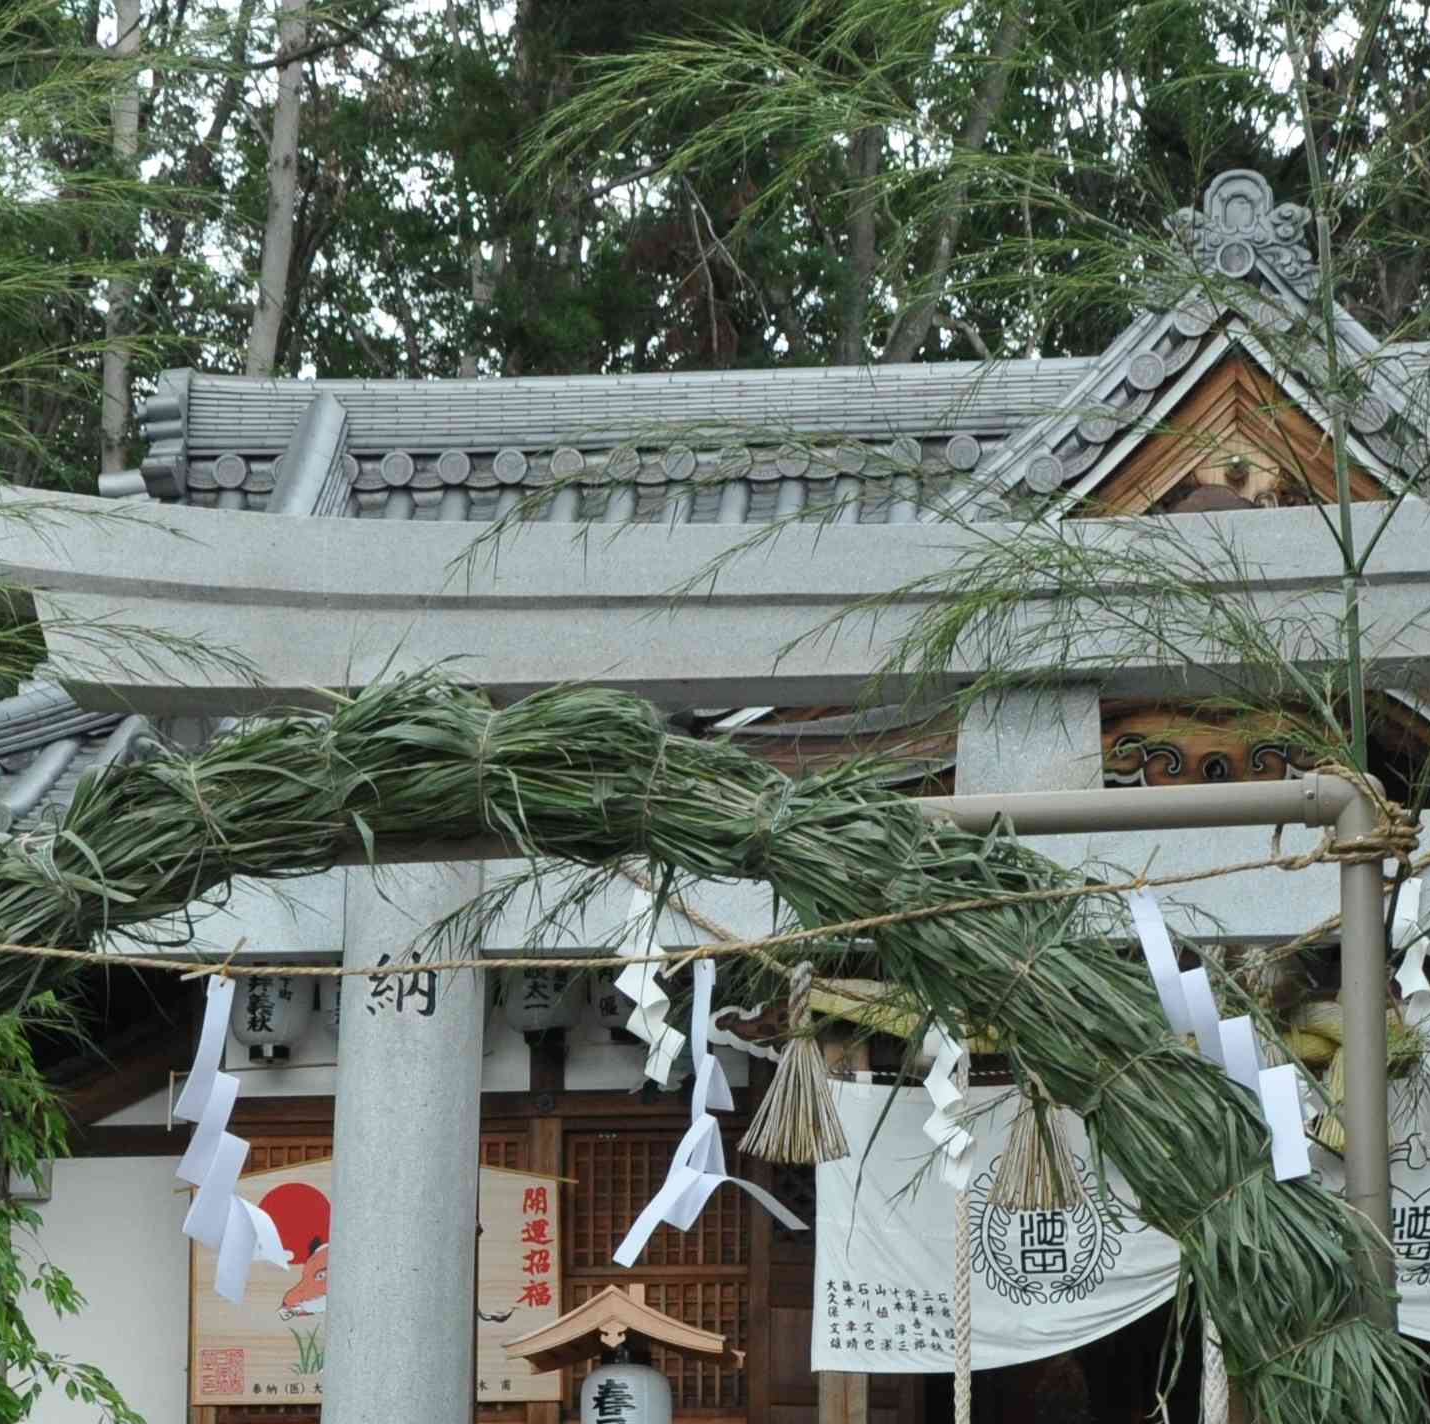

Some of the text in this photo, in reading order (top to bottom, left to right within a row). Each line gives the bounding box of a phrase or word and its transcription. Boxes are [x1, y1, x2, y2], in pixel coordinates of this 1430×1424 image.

[366, 952, 438, 1017] 納
[516, 1186, 555, 1308] 開運招福
